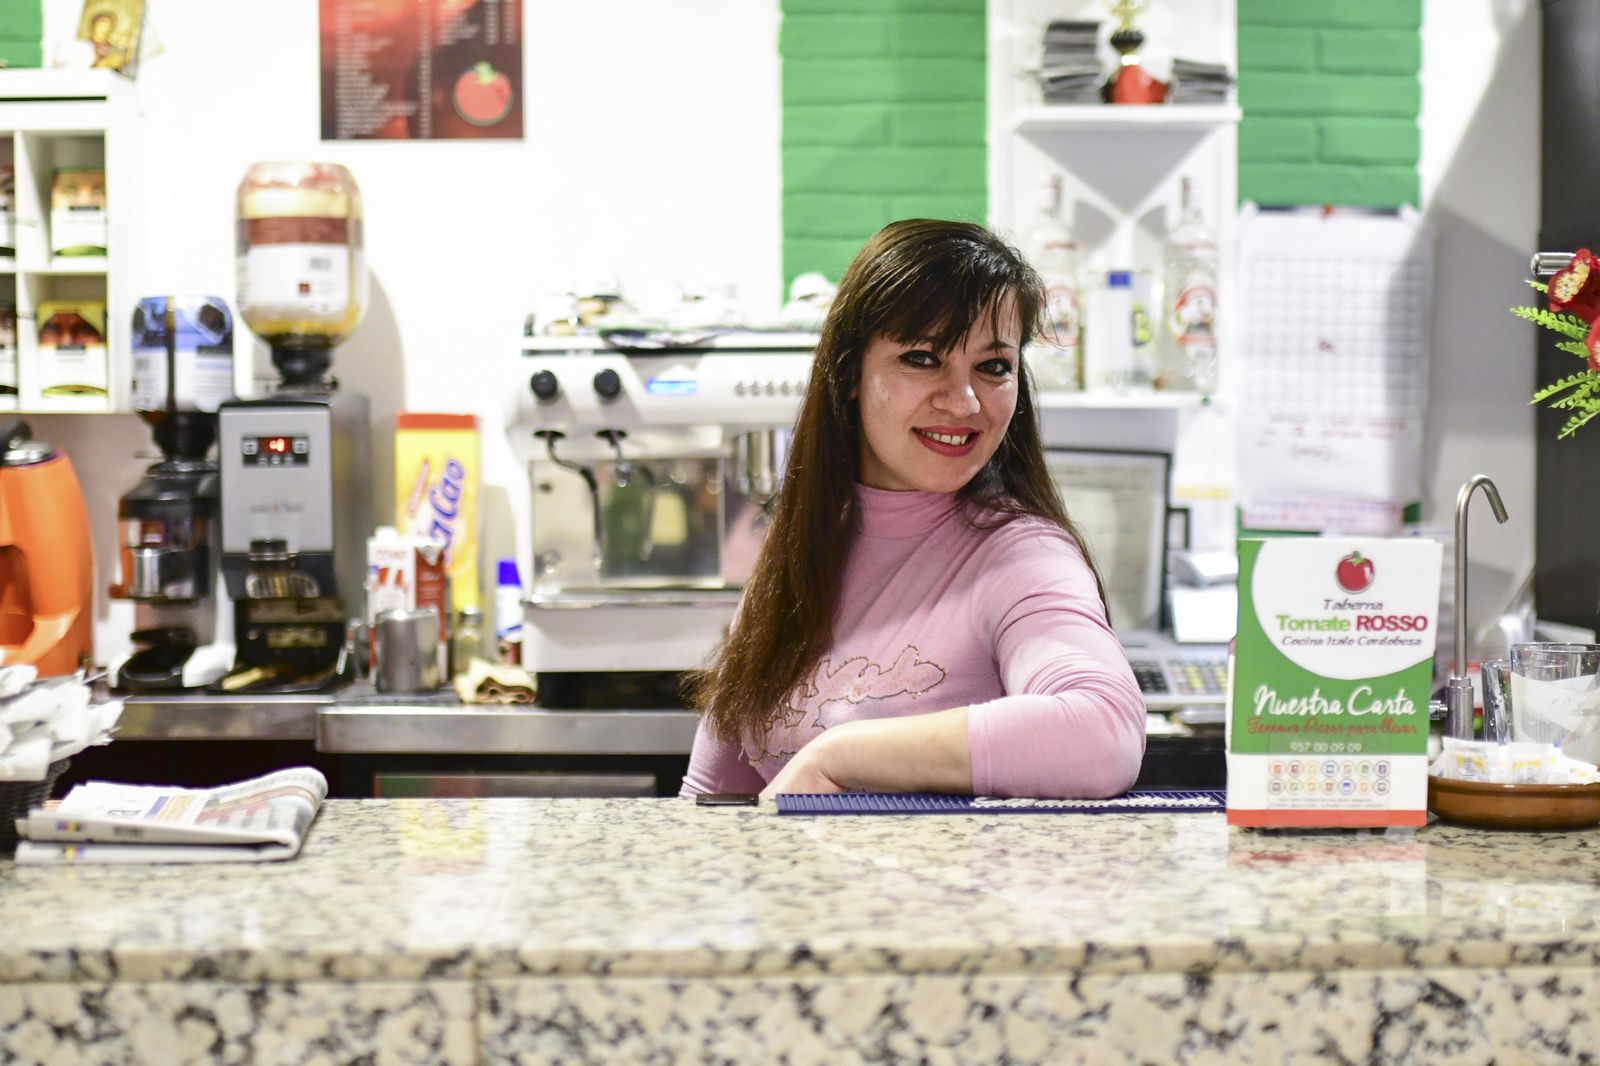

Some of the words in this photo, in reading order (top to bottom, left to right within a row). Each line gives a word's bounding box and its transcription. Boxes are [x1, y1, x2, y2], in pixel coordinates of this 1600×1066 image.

[1324, 599, 1384, 611] Taberna
[1276, 615, 1351, 632] Tomate
[1356, 615, 1429, 632] ROSSO
[1282, 635, 1324, 646] Cocina
[1326, 635, 1354, 646] Italo
[1357, 635, 1422, 646] Cordobesa
[1253, 684, 1344, 716] Nuestra
[1347, 685, 1417, 716] Carta
